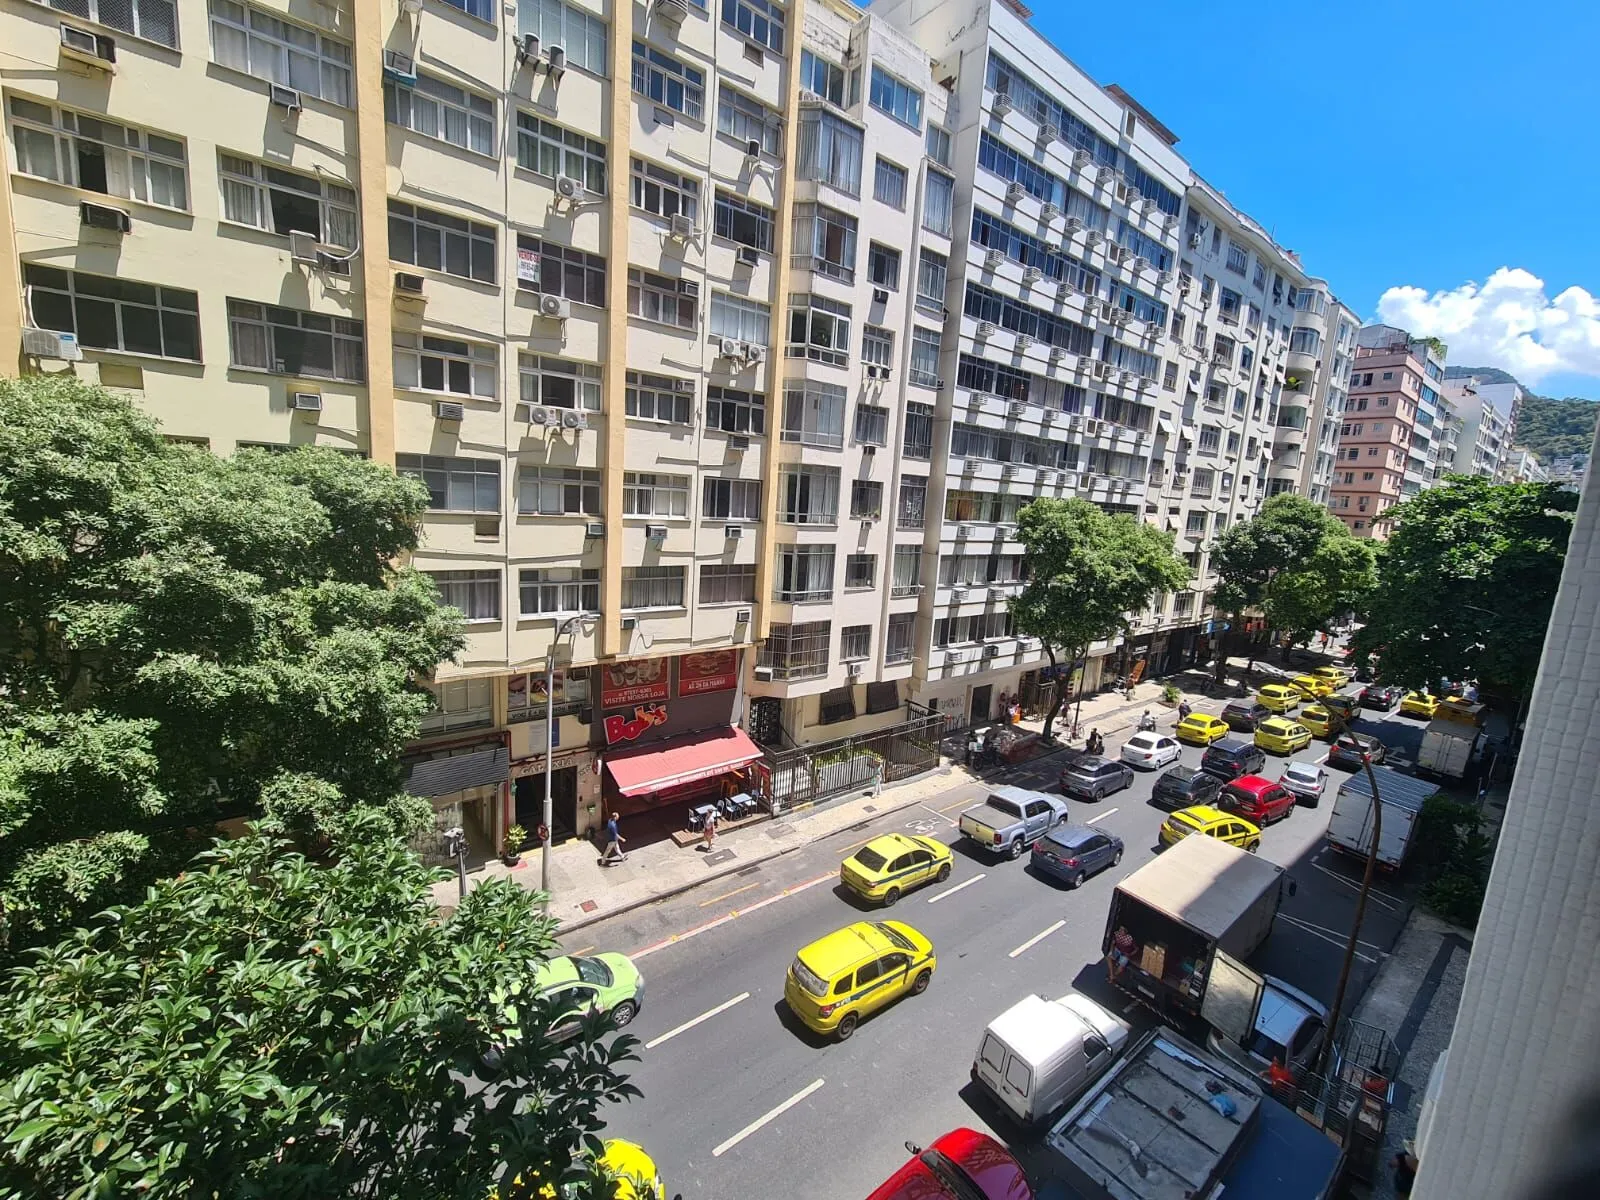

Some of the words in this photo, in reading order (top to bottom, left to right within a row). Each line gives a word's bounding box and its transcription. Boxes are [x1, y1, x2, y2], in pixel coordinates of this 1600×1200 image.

[604, 695, 627, 705] VISITE
[628, 692, 649, 702] NOSSA
[650, 689, 665, 699] LOJA
[521, 758, 574, 775] GALXIA
